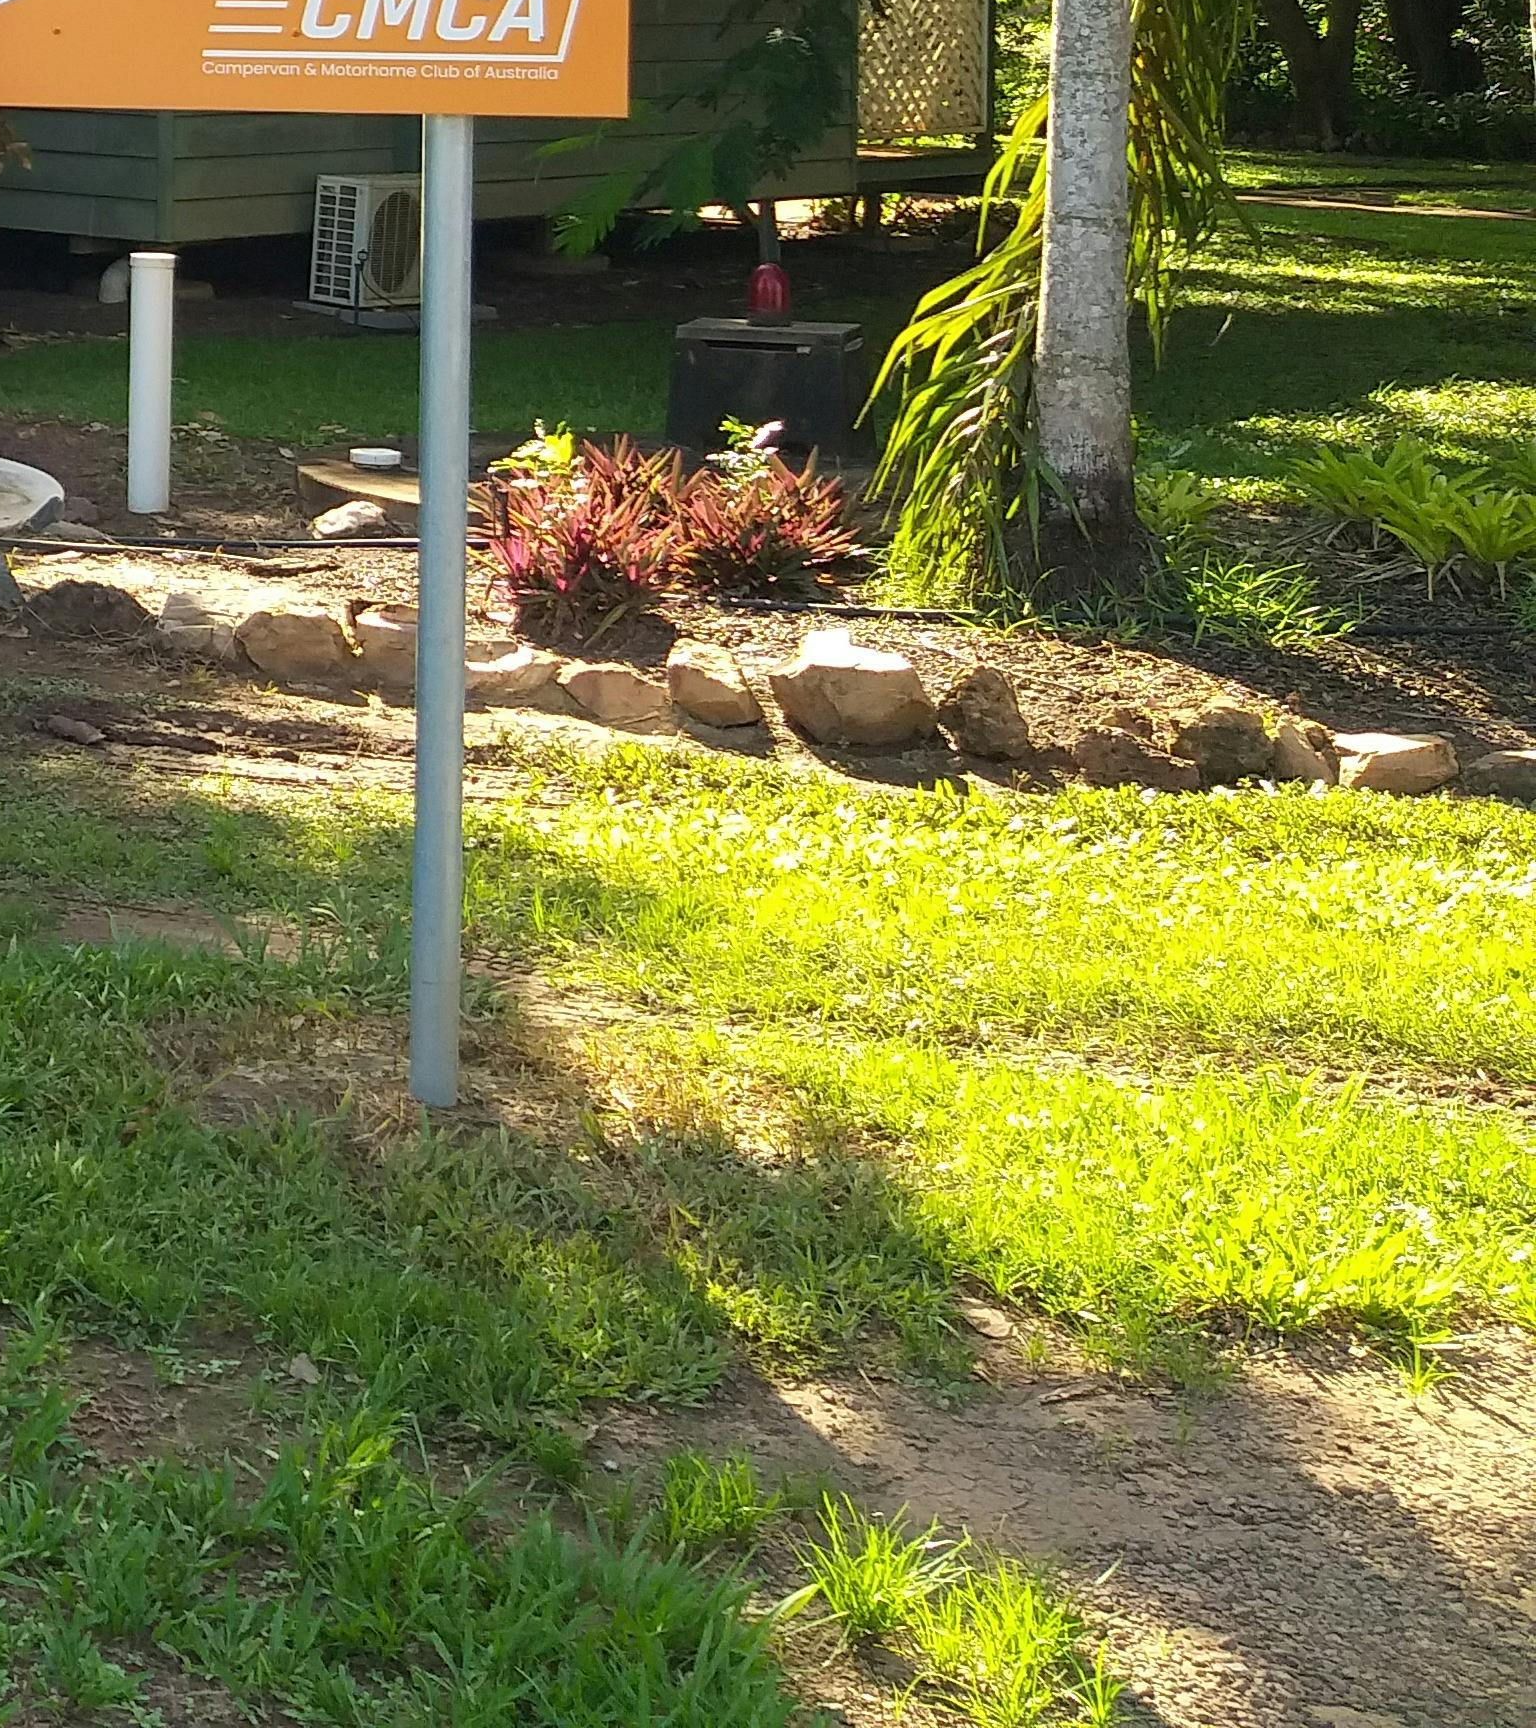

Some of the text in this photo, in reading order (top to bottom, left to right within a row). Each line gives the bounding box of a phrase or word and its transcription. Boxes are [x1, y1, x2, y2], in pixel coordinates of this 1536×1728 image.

[202, 61, 558, 79] Campervan & Motorhome Club of Australia
